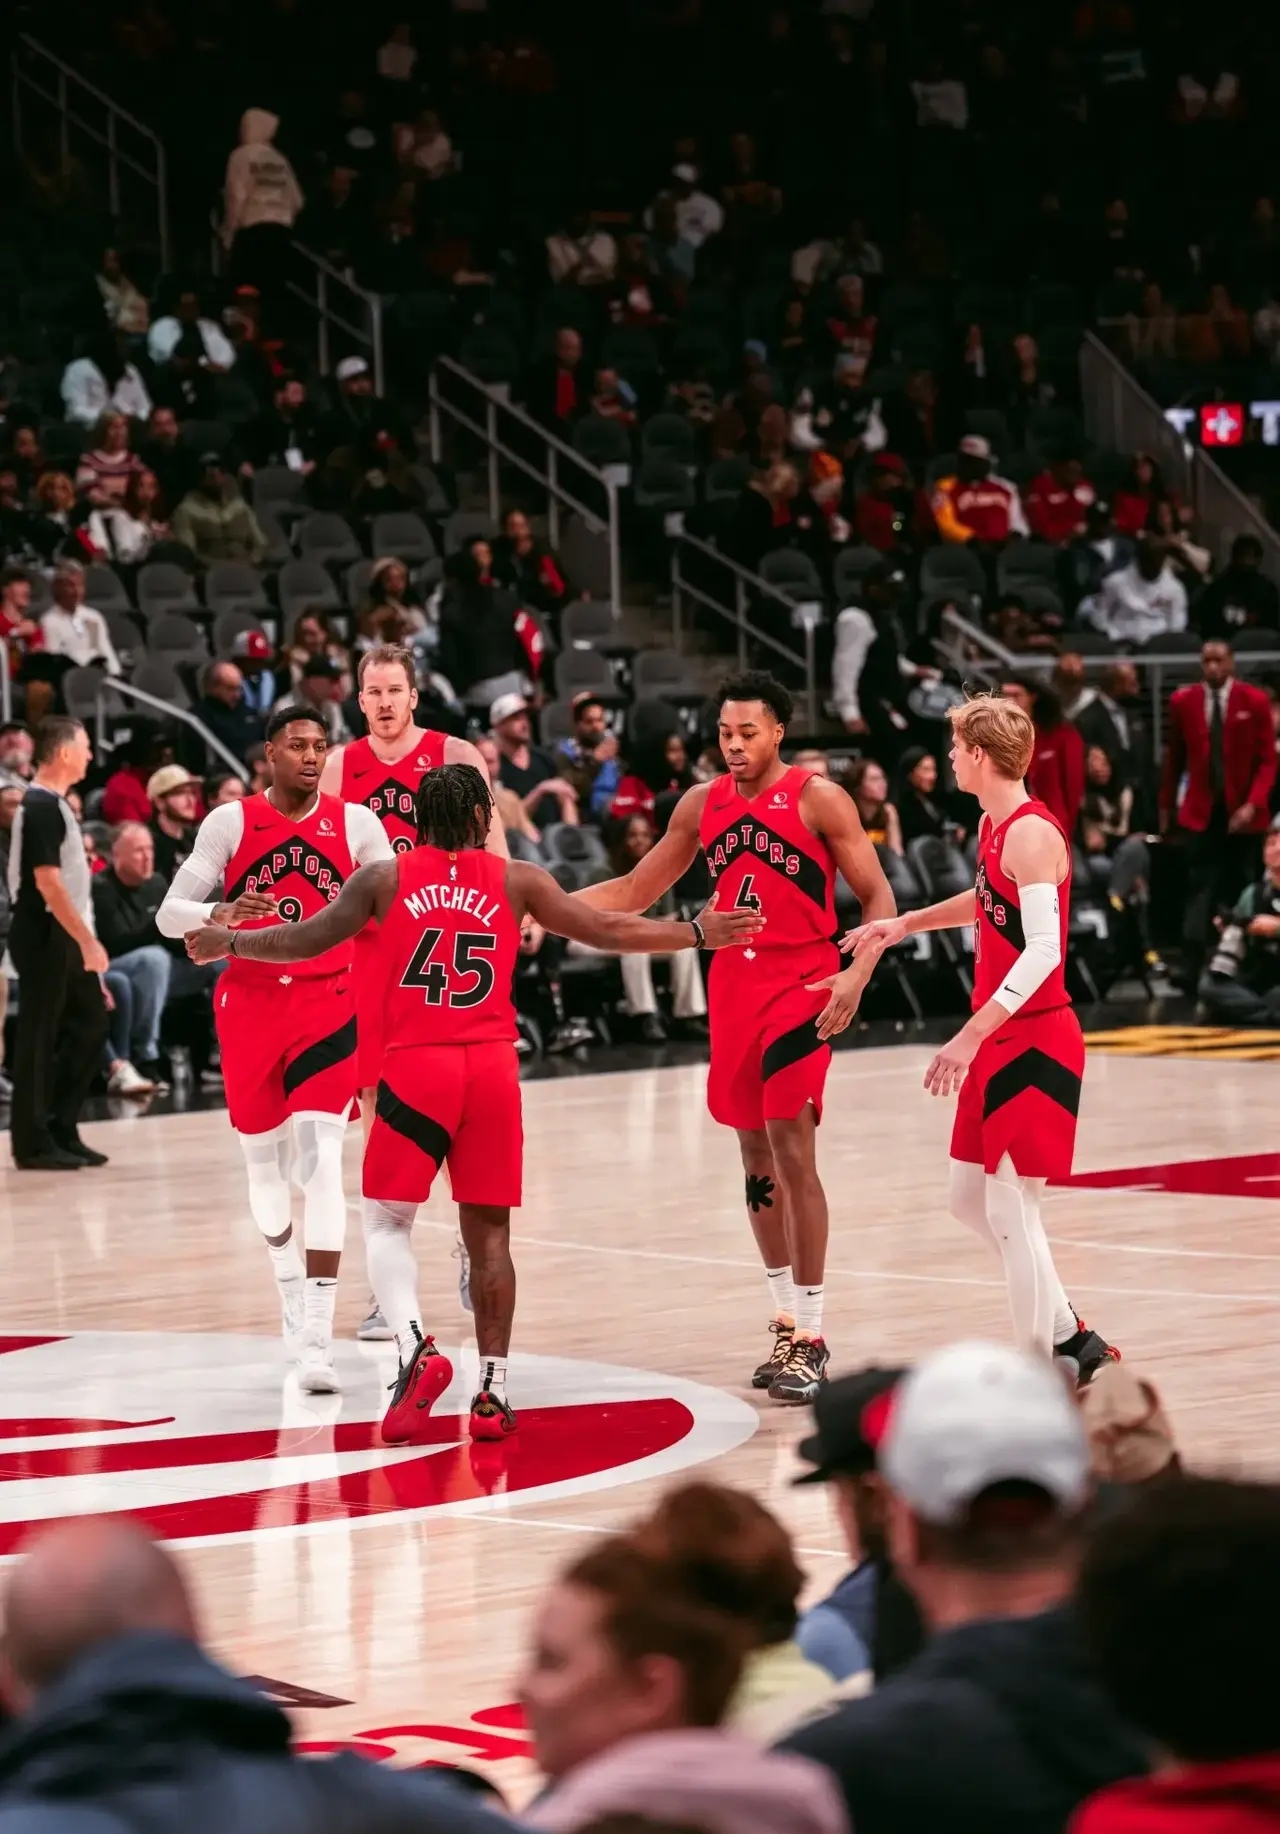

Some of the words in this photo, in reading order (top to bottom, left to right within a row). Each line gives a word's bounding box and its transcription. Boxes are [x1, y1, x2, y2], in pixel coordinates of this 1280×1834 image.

[245, 847, 341, 901] RAPTORS
[733, 874, 762, 916] 4
[277, 896, 303, 923] 9
[403, 884, 501, 928] MITCHELL
[398, 927, 498, 1009] 45
